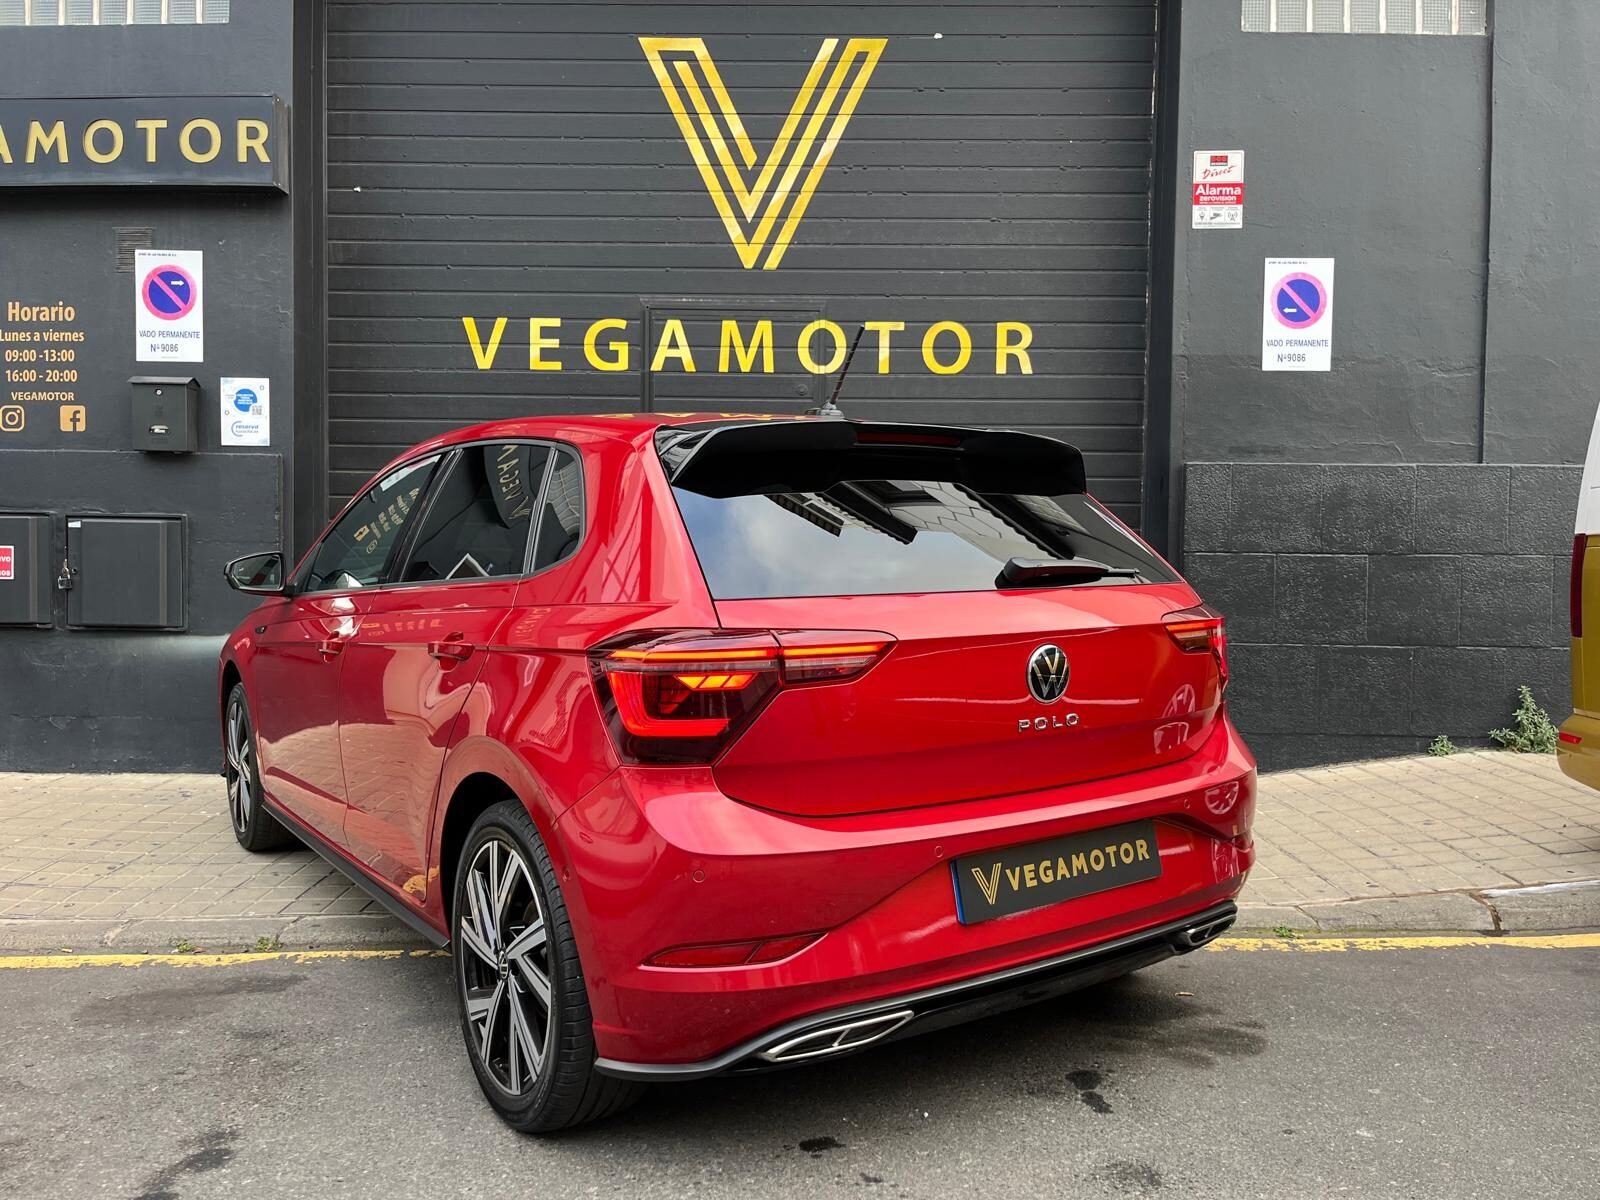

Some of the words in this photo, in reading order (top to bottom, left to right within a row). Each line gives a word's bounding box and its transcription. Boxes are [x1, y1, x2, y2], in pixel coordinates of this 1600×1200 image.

[1195, 183, 1241, 196] Alarma
[8, 301, 75, 321] Horario
[0, 329, 31, 341] Lunes
[33, 332, 40, 341] a
[43, 329, 85, 341] viernes
[139, 330, 156, 338] VADO
[158, 330, 201, 339] PERMANENTE
[462, 317, 1034, 374] VEGAMOTOR
[1266, 339, 1283, 347] VADO
[1285, 339, 1329, 347] PERMANENTE
[5, 350, 36, 362] 09:00
[5, 370, 36, 382] 16:00
[45, 370, 78, 382] 20:00
[11, 391, 75, 401] VEGAMOTOR
[1018, 713, 1079, 733] POLO
[1005, 839, 1150, 891] VEGAMOTOR
